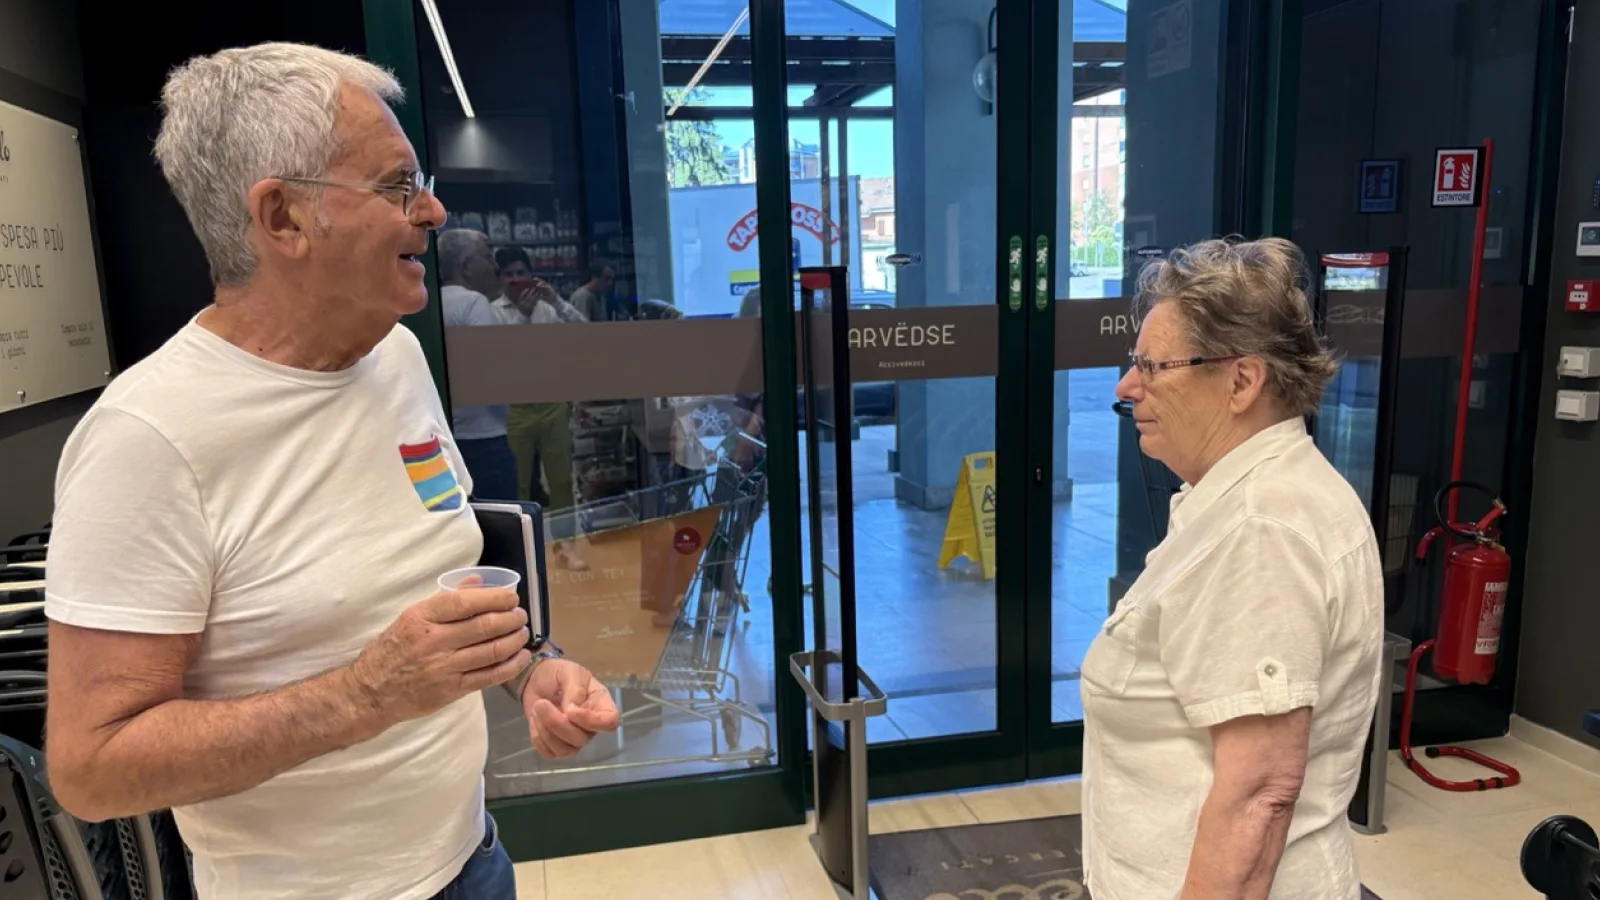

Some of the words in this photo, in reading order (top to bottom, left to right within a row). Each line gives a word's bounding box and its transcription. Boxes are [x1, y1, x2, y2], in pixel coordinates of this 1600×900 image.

[1437, 192, 1471, 202] ESTINTORE
[0, 223, 39, 249] SPESA
[43, 221, 64, 252] PIÙ
[848, 321, 956, 349] ARVËDSE
[1100, 314, 1141, 336] ARV
